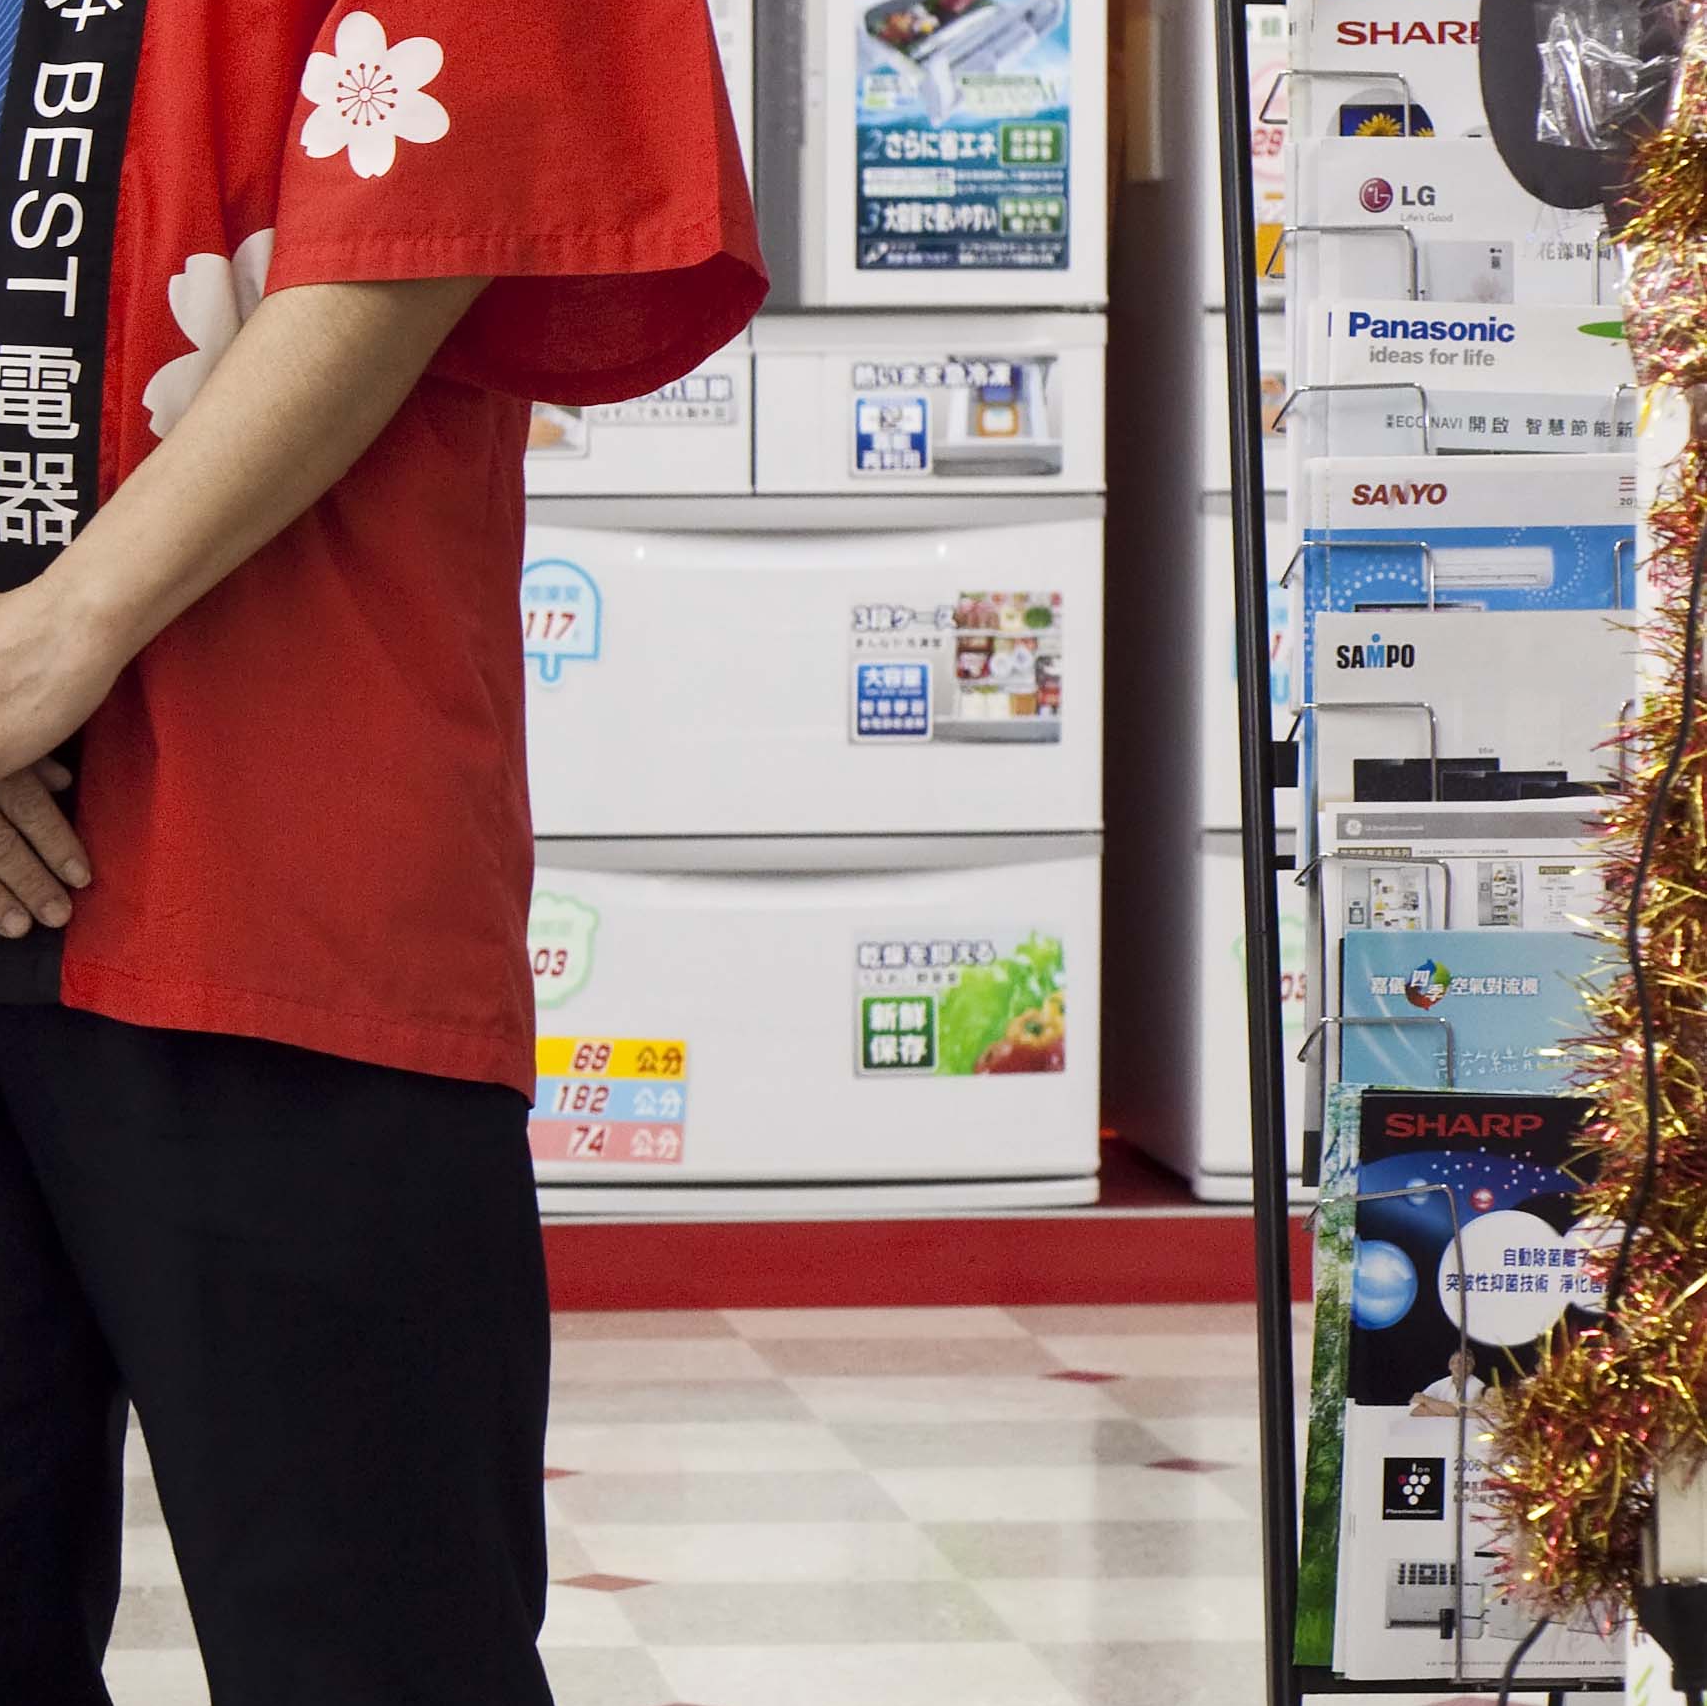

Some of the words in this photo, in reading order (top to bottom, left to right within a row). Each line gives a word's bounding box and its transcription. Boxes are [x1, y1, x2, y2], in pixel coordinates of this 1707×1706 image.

[1401, 185, 1436, 207] LG
[1427, 213, 1453, 223] Good
[1349, 312, 1515, 343] Panasonic
[1369, 346, 1424, 364] ideas
[1429, 346, 1459, 365] for
[1462, 349, 1494, 366] life
[1352, 483, 1447, 506] SANYO
[1336, 633, 1415, 669] SAMPO
[637, 1046, 682, 1075] 公分
[557, 1085, 610, 1114] 182
[633, 1086, 682, 1117] 公分
[1385, 1113, 1544, 1138] SHARP
[573, 1126, 607, 1154] 74
[630, 1128, 680, 1159] 公分
